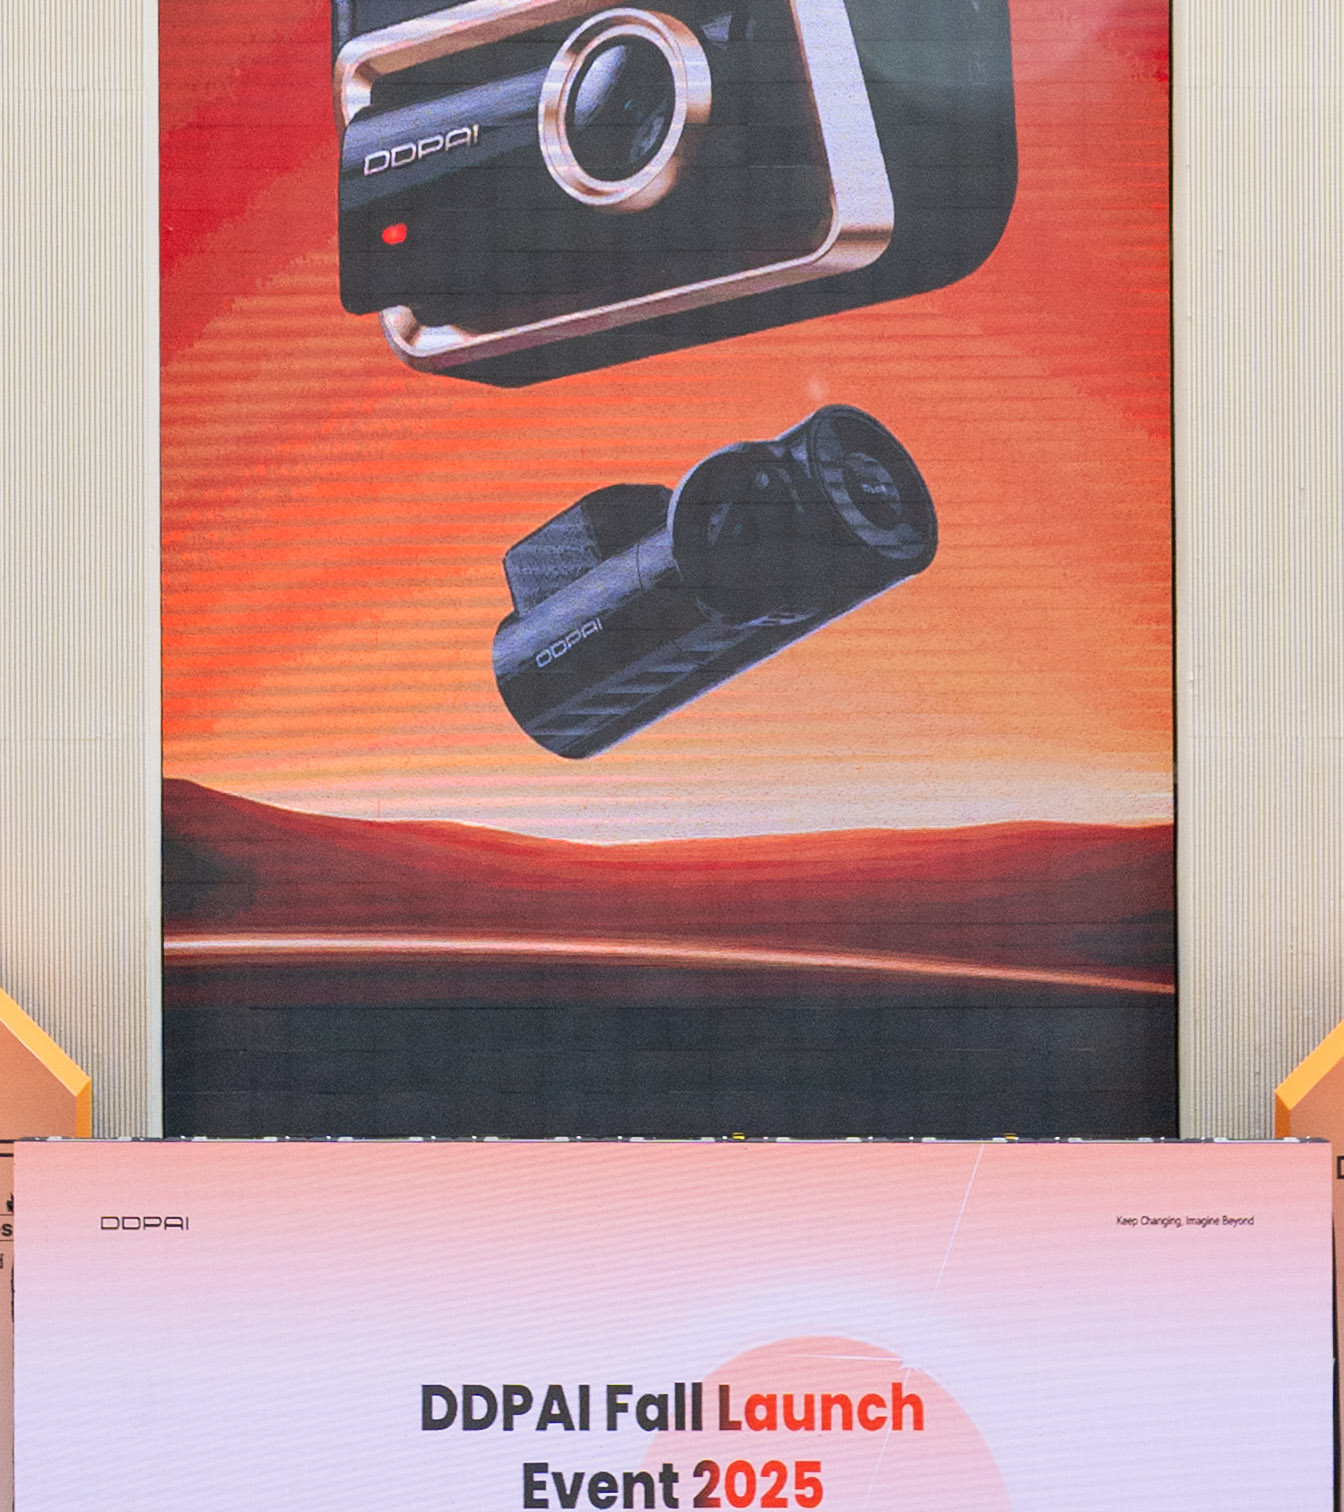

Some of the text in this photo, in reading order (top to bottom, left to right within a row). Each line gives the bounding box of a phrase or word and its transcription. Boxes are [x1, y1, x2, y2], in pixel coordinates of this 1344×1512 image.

[363, 123, 480, 176] DDPAI
[535, 617, 603, 668] DDPAI
[100, 1216, 189, 1231] DDPAI
[1116, 1216, 1138, 1228] Keep
[1186, 1216, 1220, 1228] Imagine
[1222, 1215, 1255, 1228] Beyond
[421, 1382, 924, 1431] DDPAI Fall Launch
[523, 1460, 825, 1509] Event 2025
